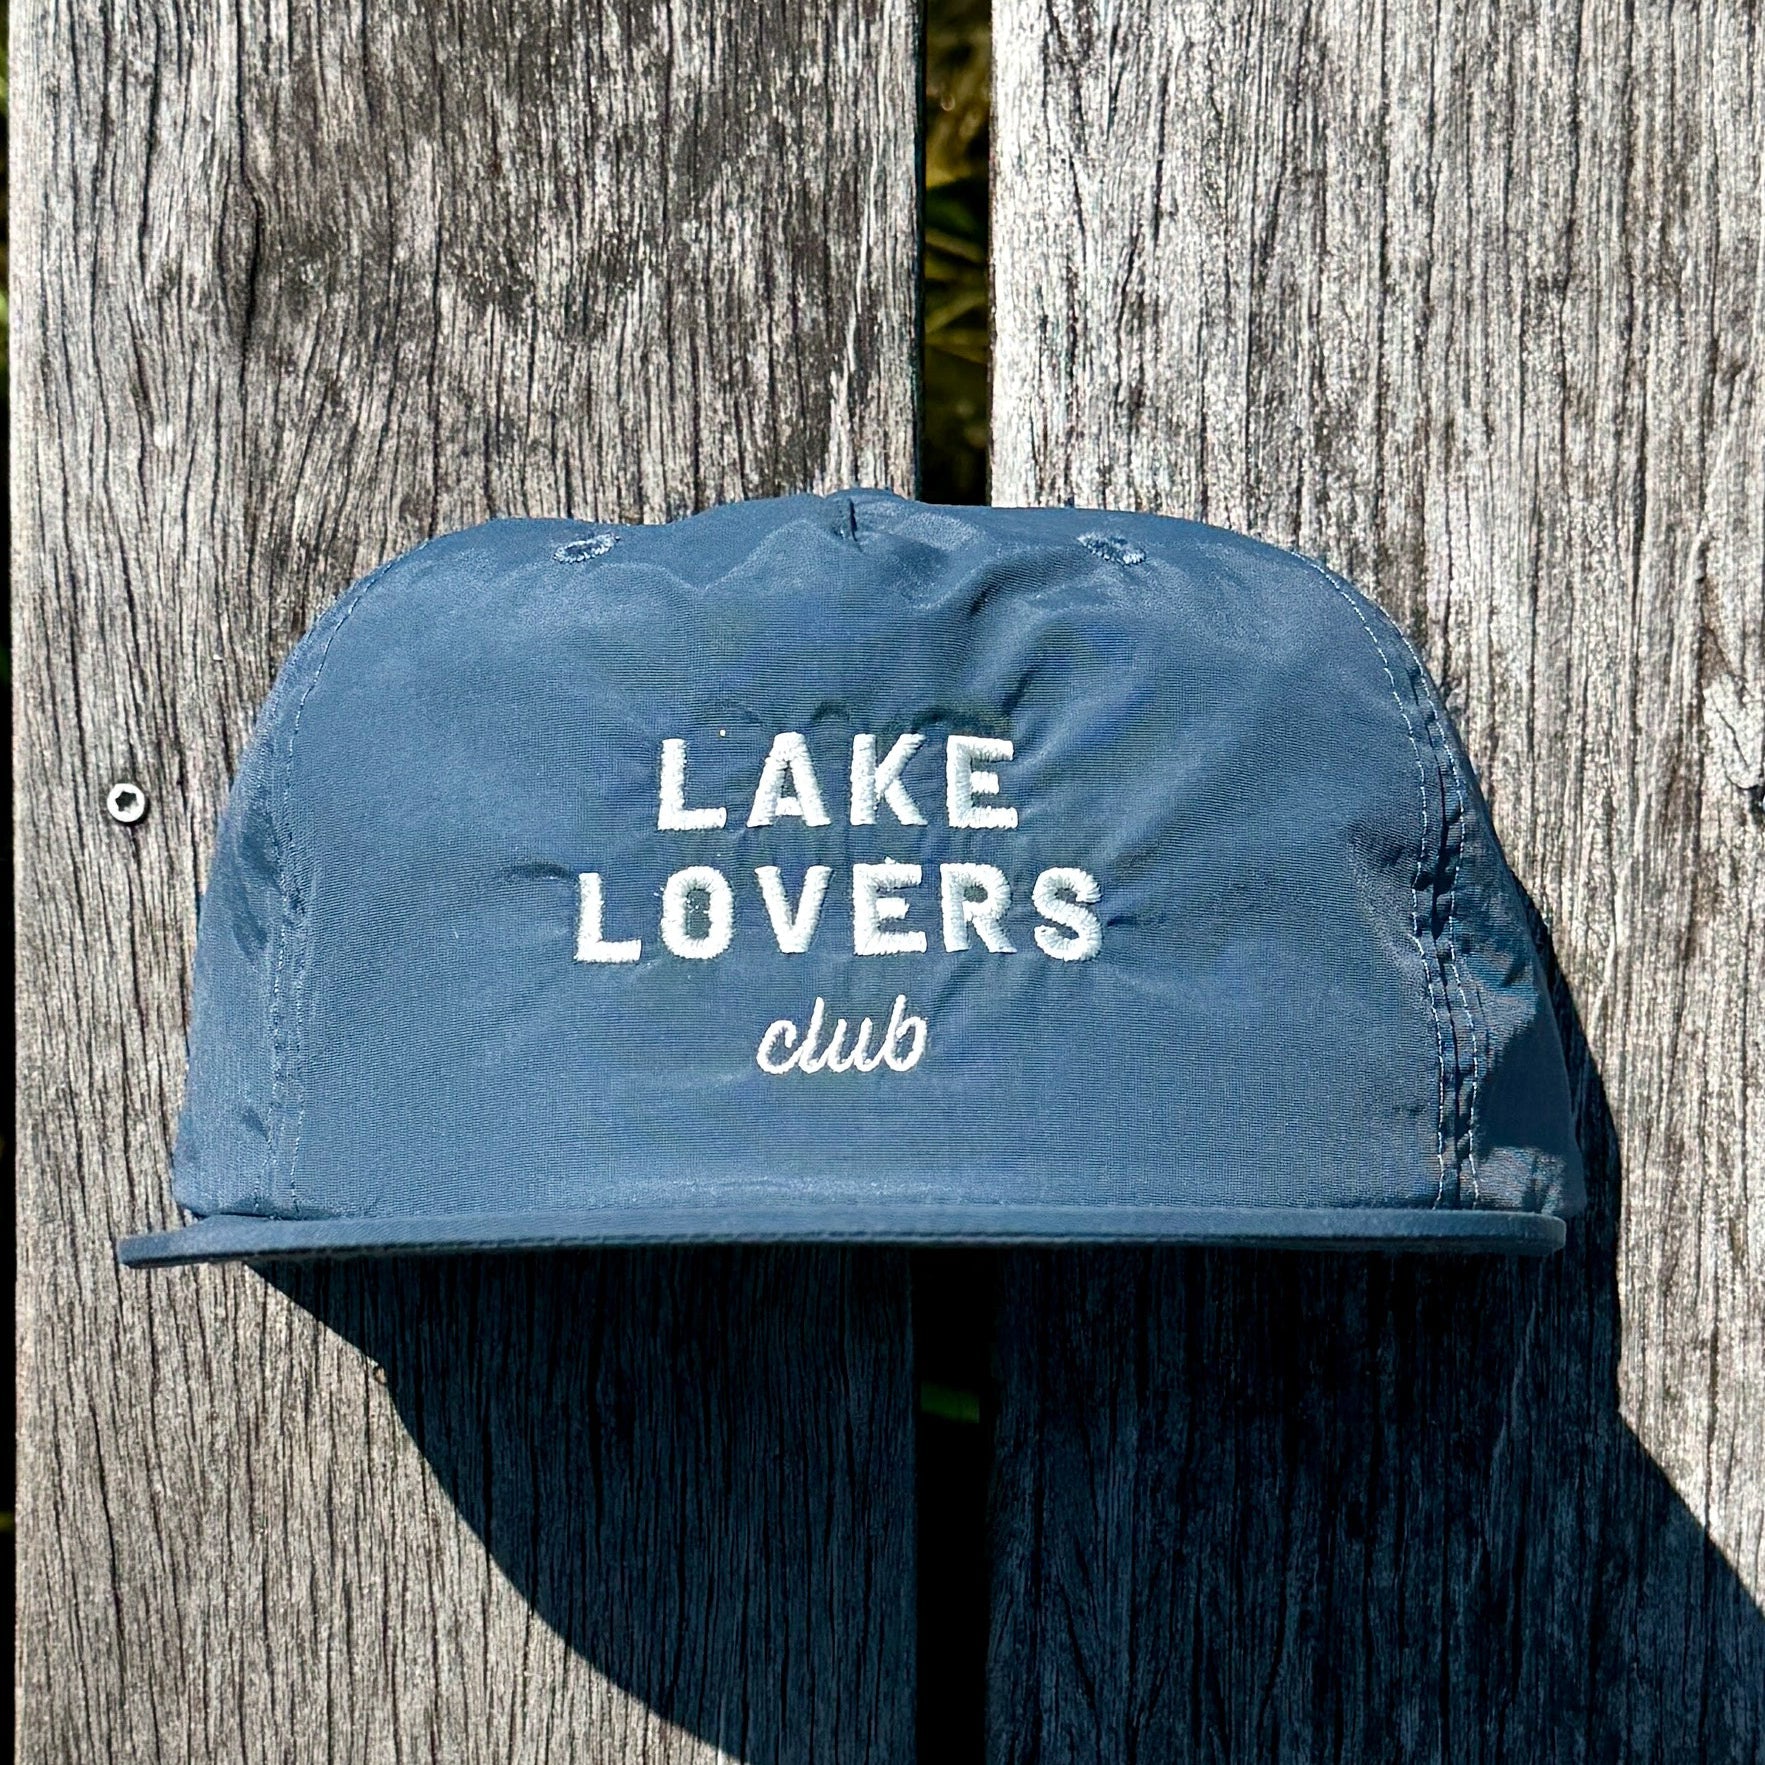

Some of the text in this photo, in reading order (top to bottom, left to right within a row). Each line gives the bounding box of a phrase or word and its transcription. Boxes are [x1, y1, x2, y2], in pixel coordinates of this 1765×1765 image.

[656, 731, 1020, 832] LAKE
[573, 857, 1102, 964] LOVERS
[755, 994, 929, 1076] club
